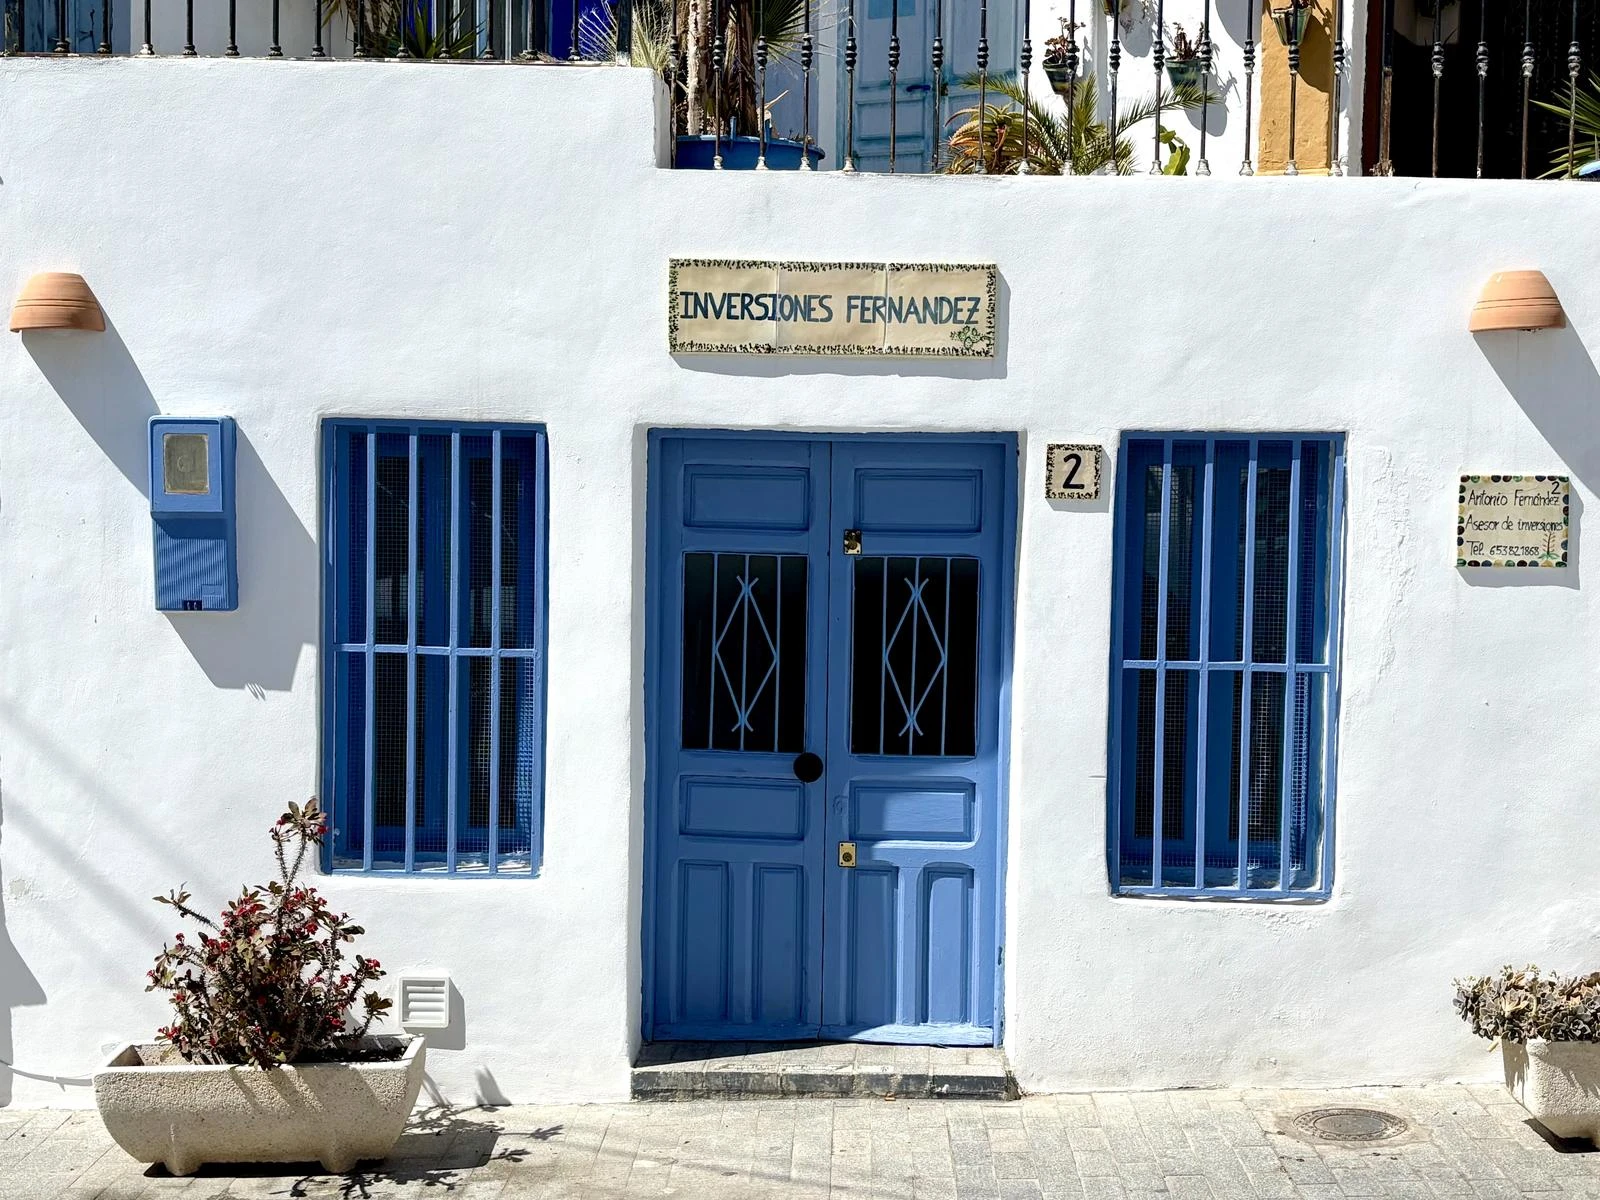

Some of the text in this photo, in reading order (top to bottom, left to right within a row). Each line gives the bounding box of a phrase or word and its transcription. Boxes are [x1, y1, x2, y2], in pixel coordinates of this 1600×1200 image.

[680, 291, 981, 325] INVERSIONES FERNANDEZ
[1063, 453, 1085, 489] 2
[1551, 481, 1561, 494] 2
[1467, 489, 1508, 506] Antonio
[1465, 514, 1500, 531] Asesor
[1501, 516, 1514, 531] de
[1466, 540, 1485, 556] Tel.
